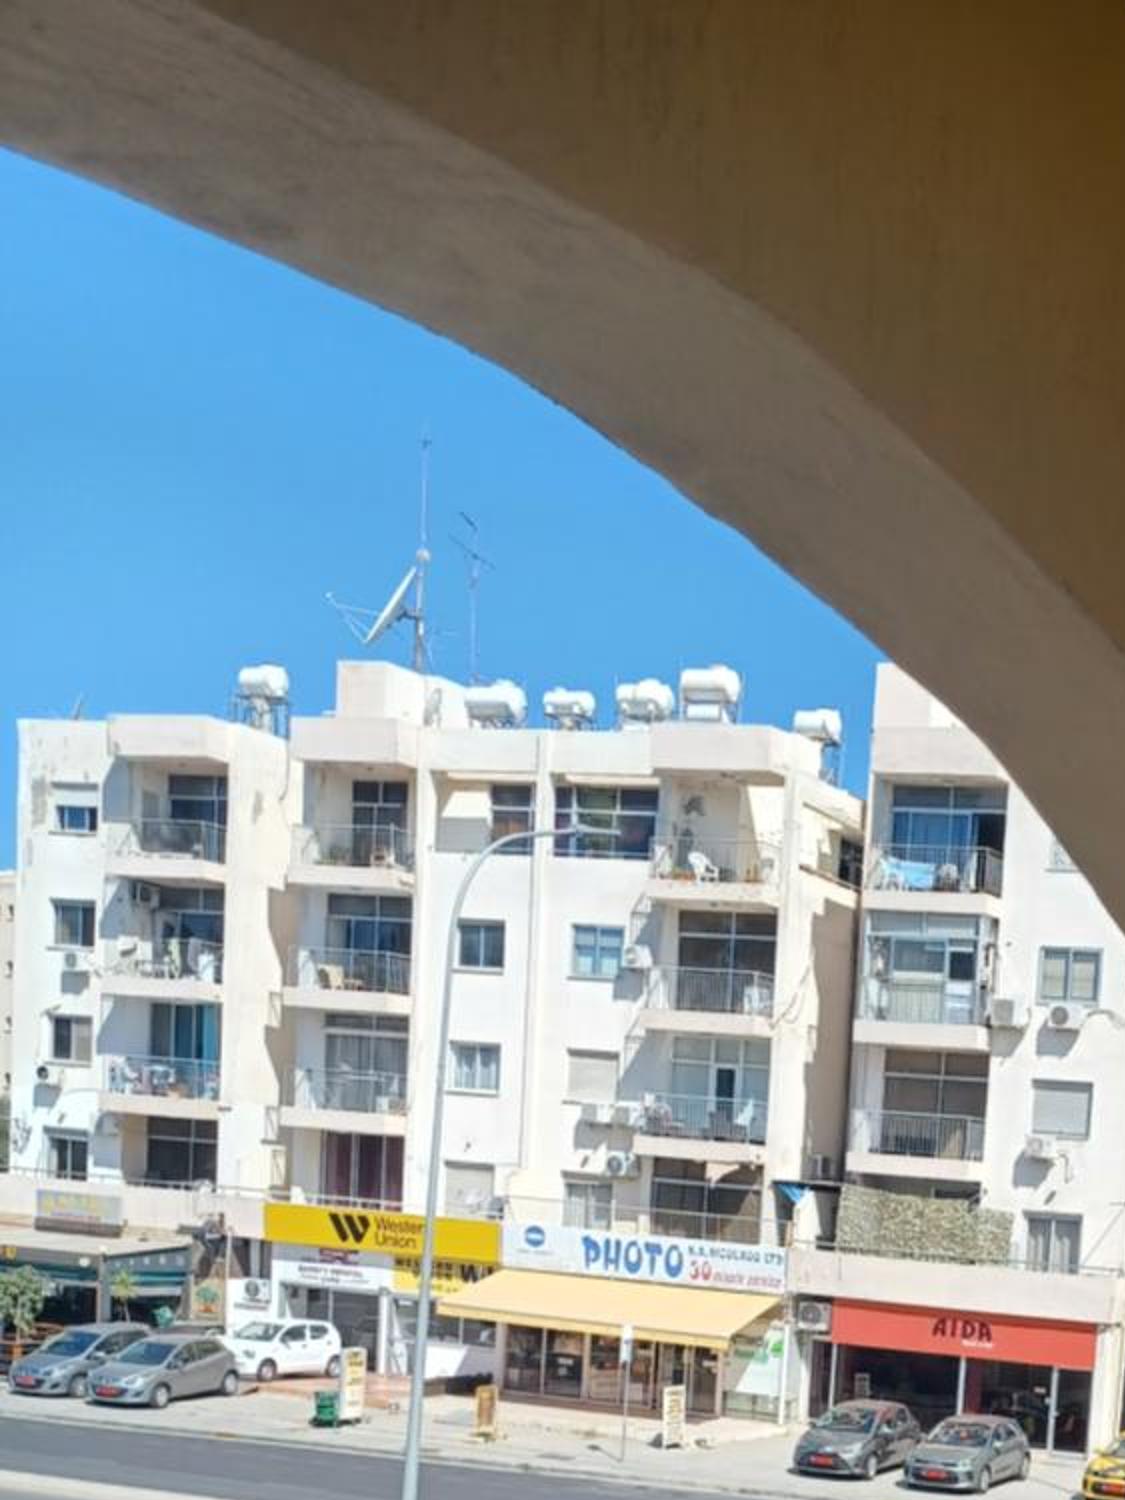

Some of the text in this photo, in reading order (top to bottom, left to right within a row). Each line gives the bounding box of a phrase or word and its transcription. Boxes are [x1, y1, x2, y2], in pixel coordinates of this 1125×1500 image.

[374, 1215, 424, 1233] Wester
[374, 1231, 417, 1249] Union
[581, 1235, 684, 1278] PHOTO
[690, 1260, 712, 1281] 30
[931, 1316, 993, 1343] AIDA
